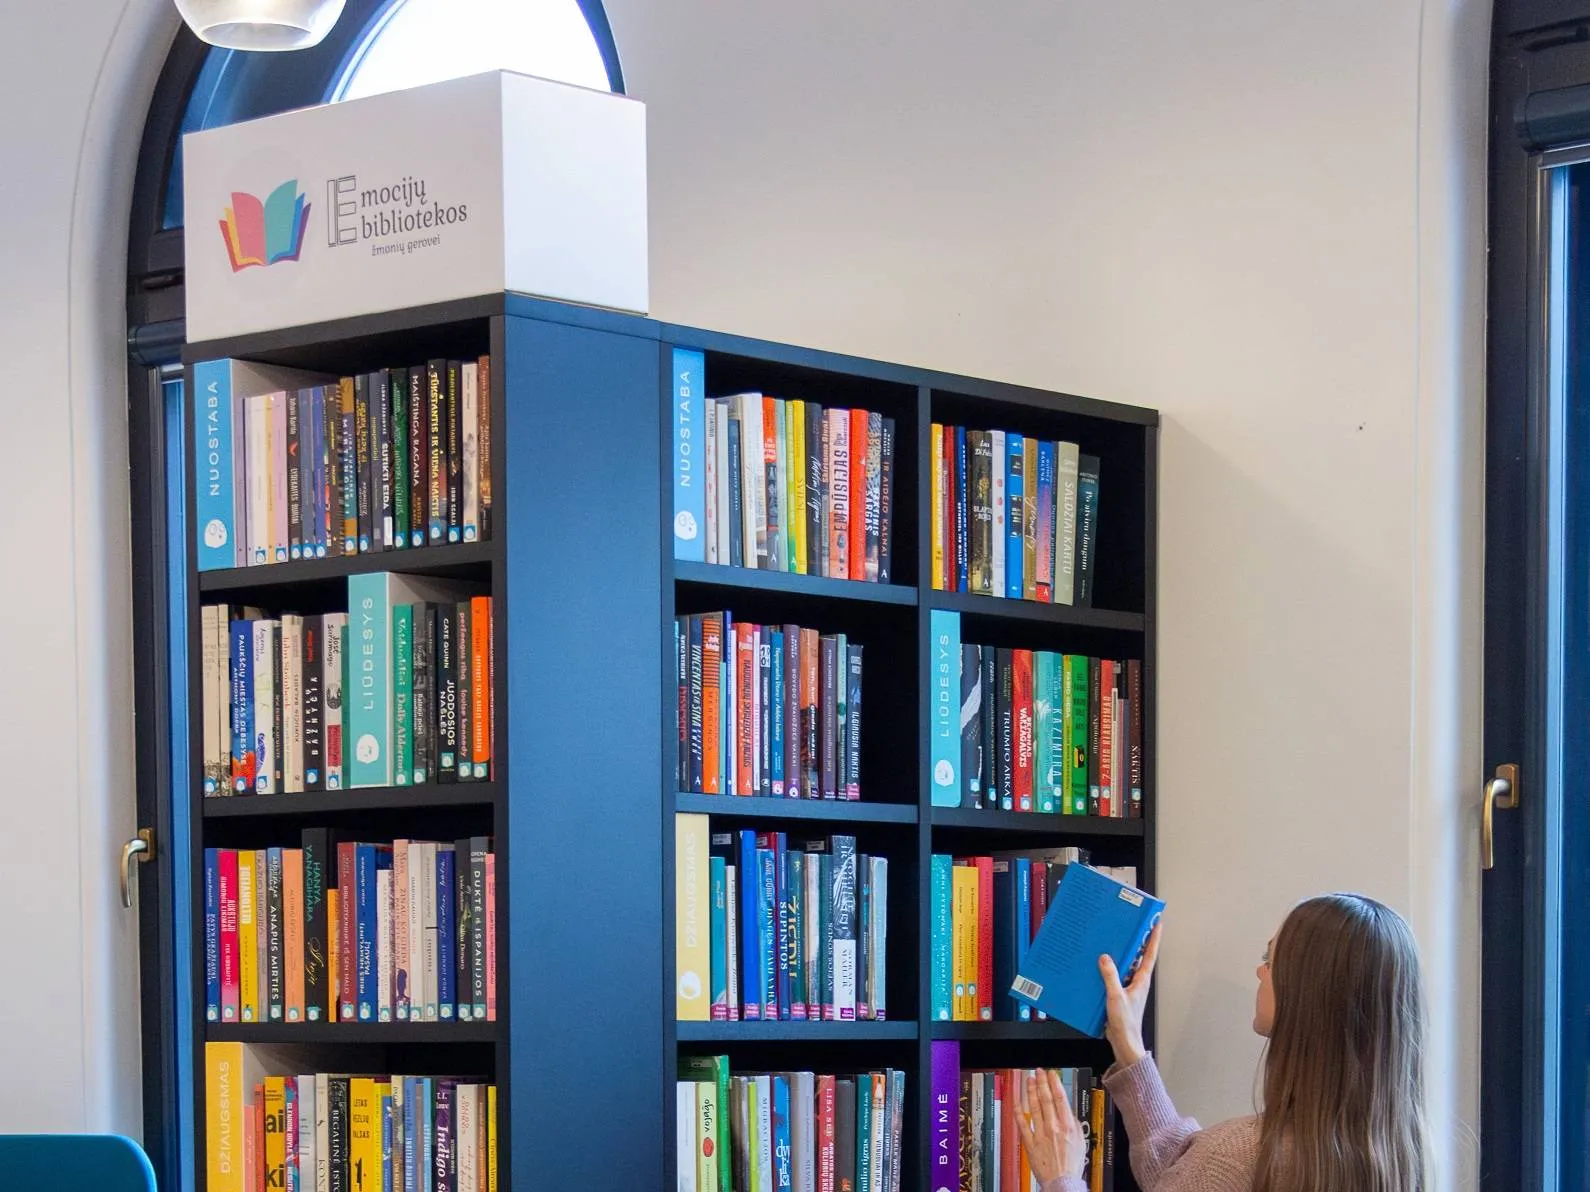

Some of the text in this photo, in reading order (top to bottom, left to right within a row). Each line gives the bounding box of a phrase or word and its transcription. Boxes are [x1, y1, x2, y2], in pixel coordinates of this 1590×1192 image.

[361, 201, 468, 239] bibliotekos
[372, 234, 441, 256] žmonių gerovei
[208, 380, 220, 496] NUOSTABA
[411, 375, 422, 487] MAIŠTINGA RAGANA
[430, 436, 439, 447] IR
[678, 371, 691, 488] NUOSTABA
[382, 443, 390, 481] SUTIKTI
[831, 449, 848, 533] EMPŪSIJAS
[865, 490, 873, 532] SARGAS
[881, 518, 889, 558] KALNAI
[326, 624, 336, 668] Saramago
[332, 634, 342, 653] José
[360, 597, 375, 711] LIŪDESYS
[237, 634, 248, 766] PAUKŠČIŲ MIESTAS DEBESYSE
[446, 680, 456, 746] JUODOSIOS
[938, 634, 950, 738] LIŪDESYS
[1003, 764, 1011, 796] ARKA
[305, 845, 313, 922] YANAGIHARA
[313, 862, 321, 905] HANYA
[270, 905, 280, 1000] ANAPUS MIRTIES
[473, 870, 483, 997] DUKTĖ ISPANIJOS
[779, 901, 788, 971] SUPINTOS
[825, 1088, 833, 1113] LISA
[937, 1093, 948, 1166] BAIMĖ
[331, 1108, 341, 1164] BEGALINĖ
[436, 1125, 450, 1177] Indigo
